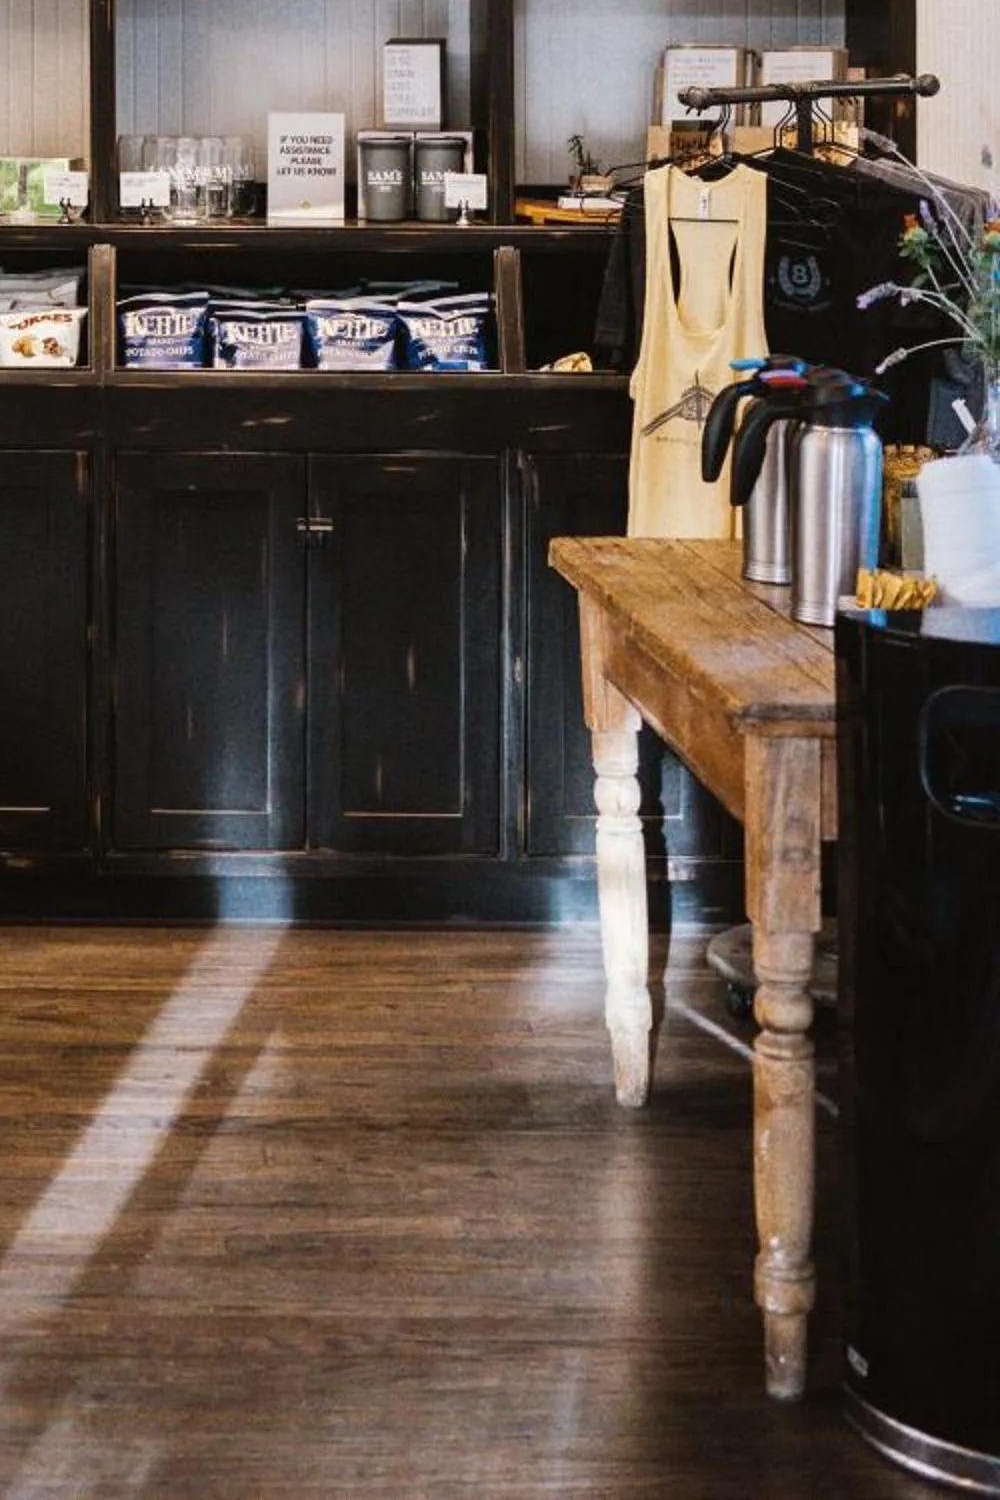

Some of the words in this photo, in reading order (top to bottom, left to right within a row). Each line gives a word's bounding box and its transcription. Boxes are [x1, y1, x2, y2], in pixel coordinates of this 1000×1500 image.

[290, 135, 309, 144] YOU
[310, 135, 333, 144] NEED
[280, 146, 331, 155] ASSISTANCE
[290, 156, 322, 165] PLEASE
[276, 167, 291, 176] LET
[791, 264, 808, 284] 8
